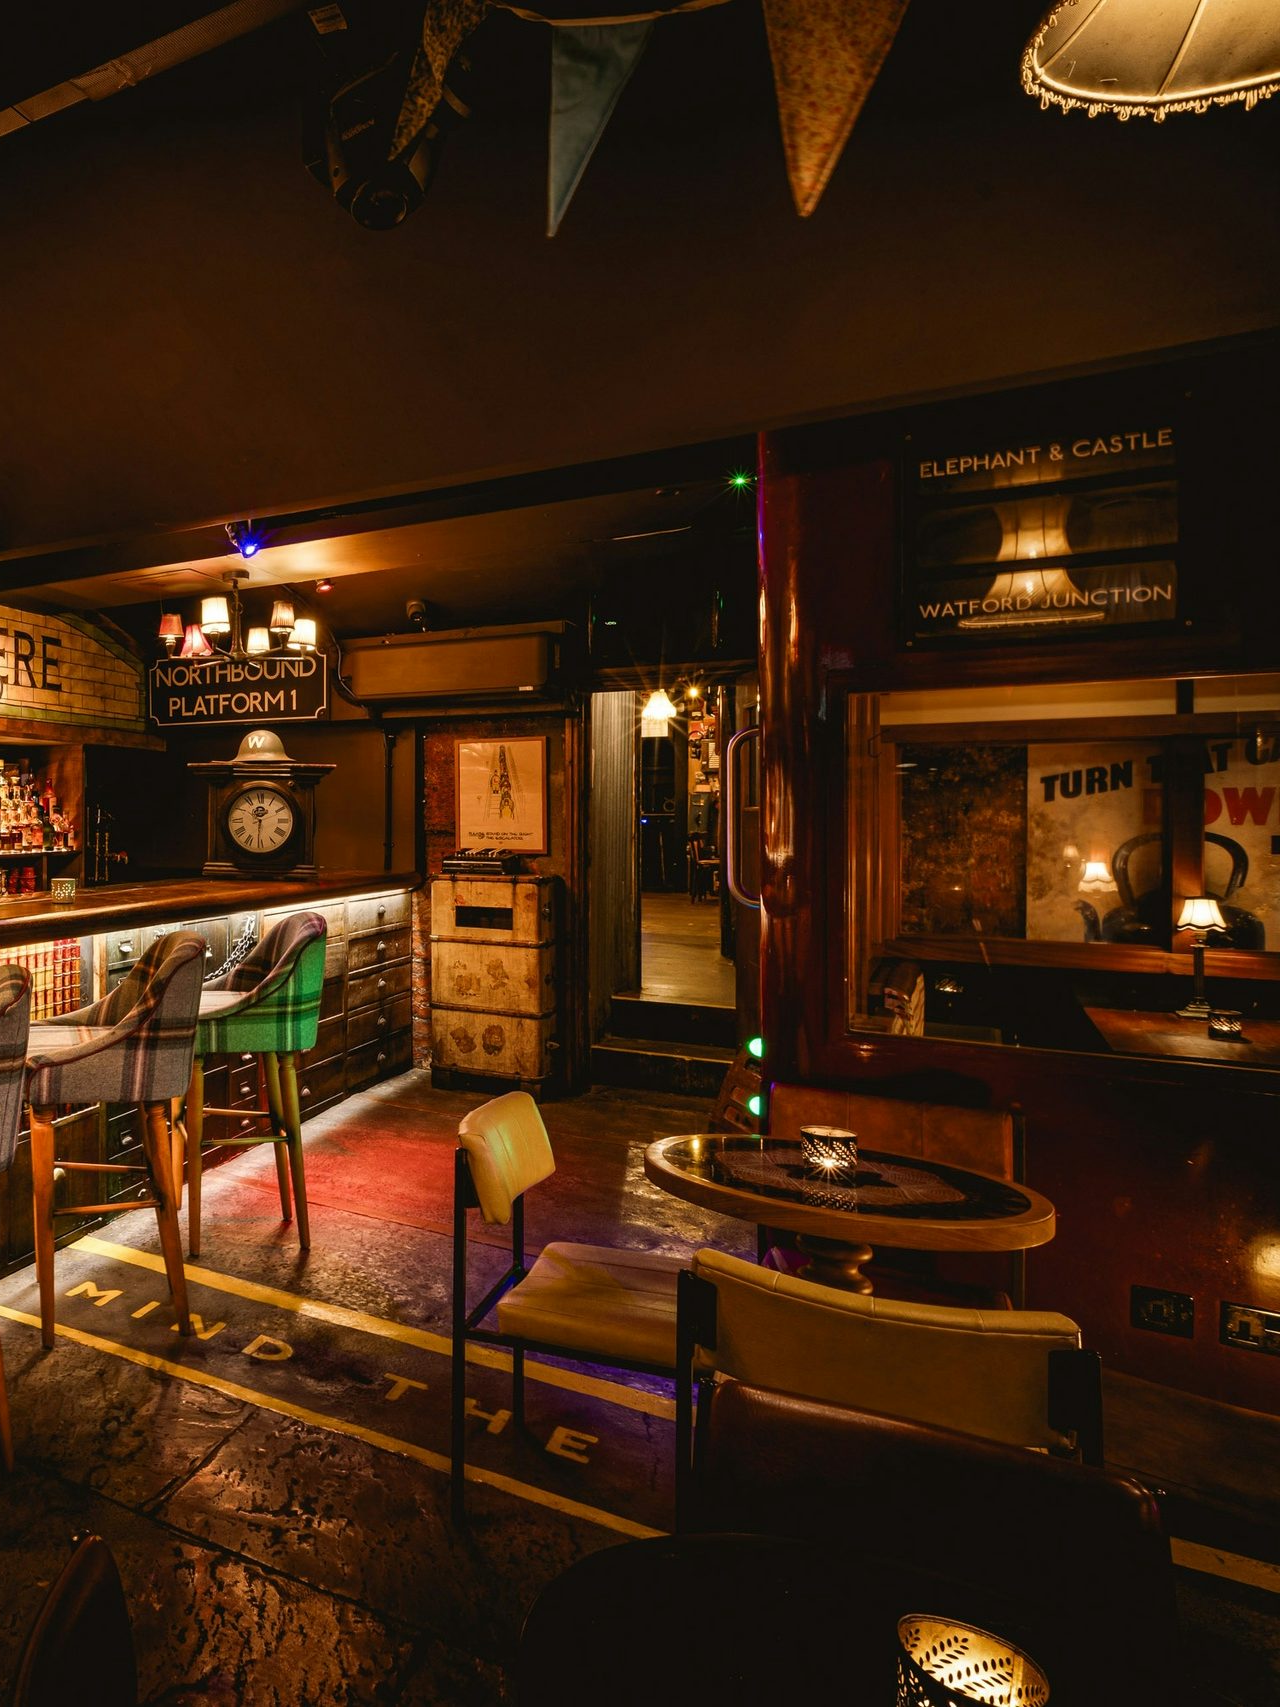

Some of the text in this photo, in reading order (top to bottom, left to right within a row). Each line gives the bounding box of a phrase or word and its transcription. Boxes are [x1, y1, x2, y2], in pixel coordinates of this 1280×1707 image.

[919, 428, 1174, 479] ELEPHANT & CASTLE
[919, 584, 1172, 619] WATFORD JUNCTION
[156, 656, 317, 688] NORTHBOUND
[169, 689, 297, 717] PLATFORM 1
[248, 736, 266, 749] W
[1040, 760, 1133, 802] TURN
[64, 1280, 600, 1464] MIND THE
